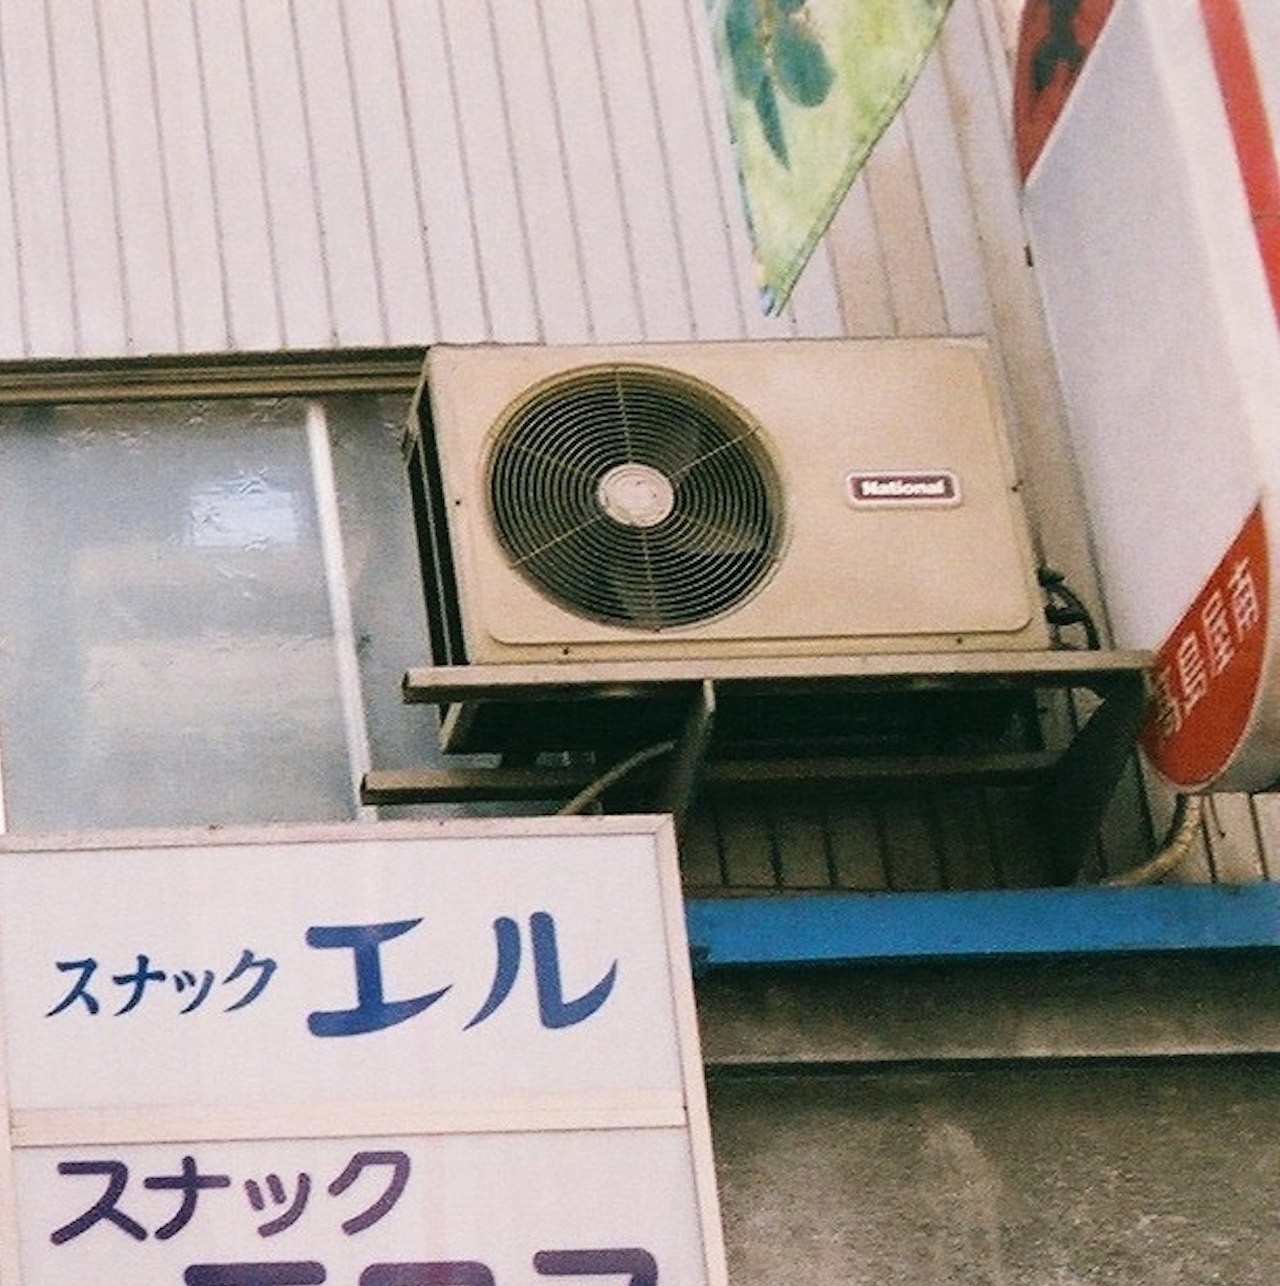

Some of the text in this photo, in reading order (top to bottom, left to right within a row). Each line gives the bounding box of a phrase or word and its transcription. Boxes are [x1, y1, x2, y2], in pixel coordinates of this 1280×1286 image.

[860, 479, 946, 497] National
[45, 911, 619, 1038] スナック エル
[49, 1150, 411, 1246] スナック
